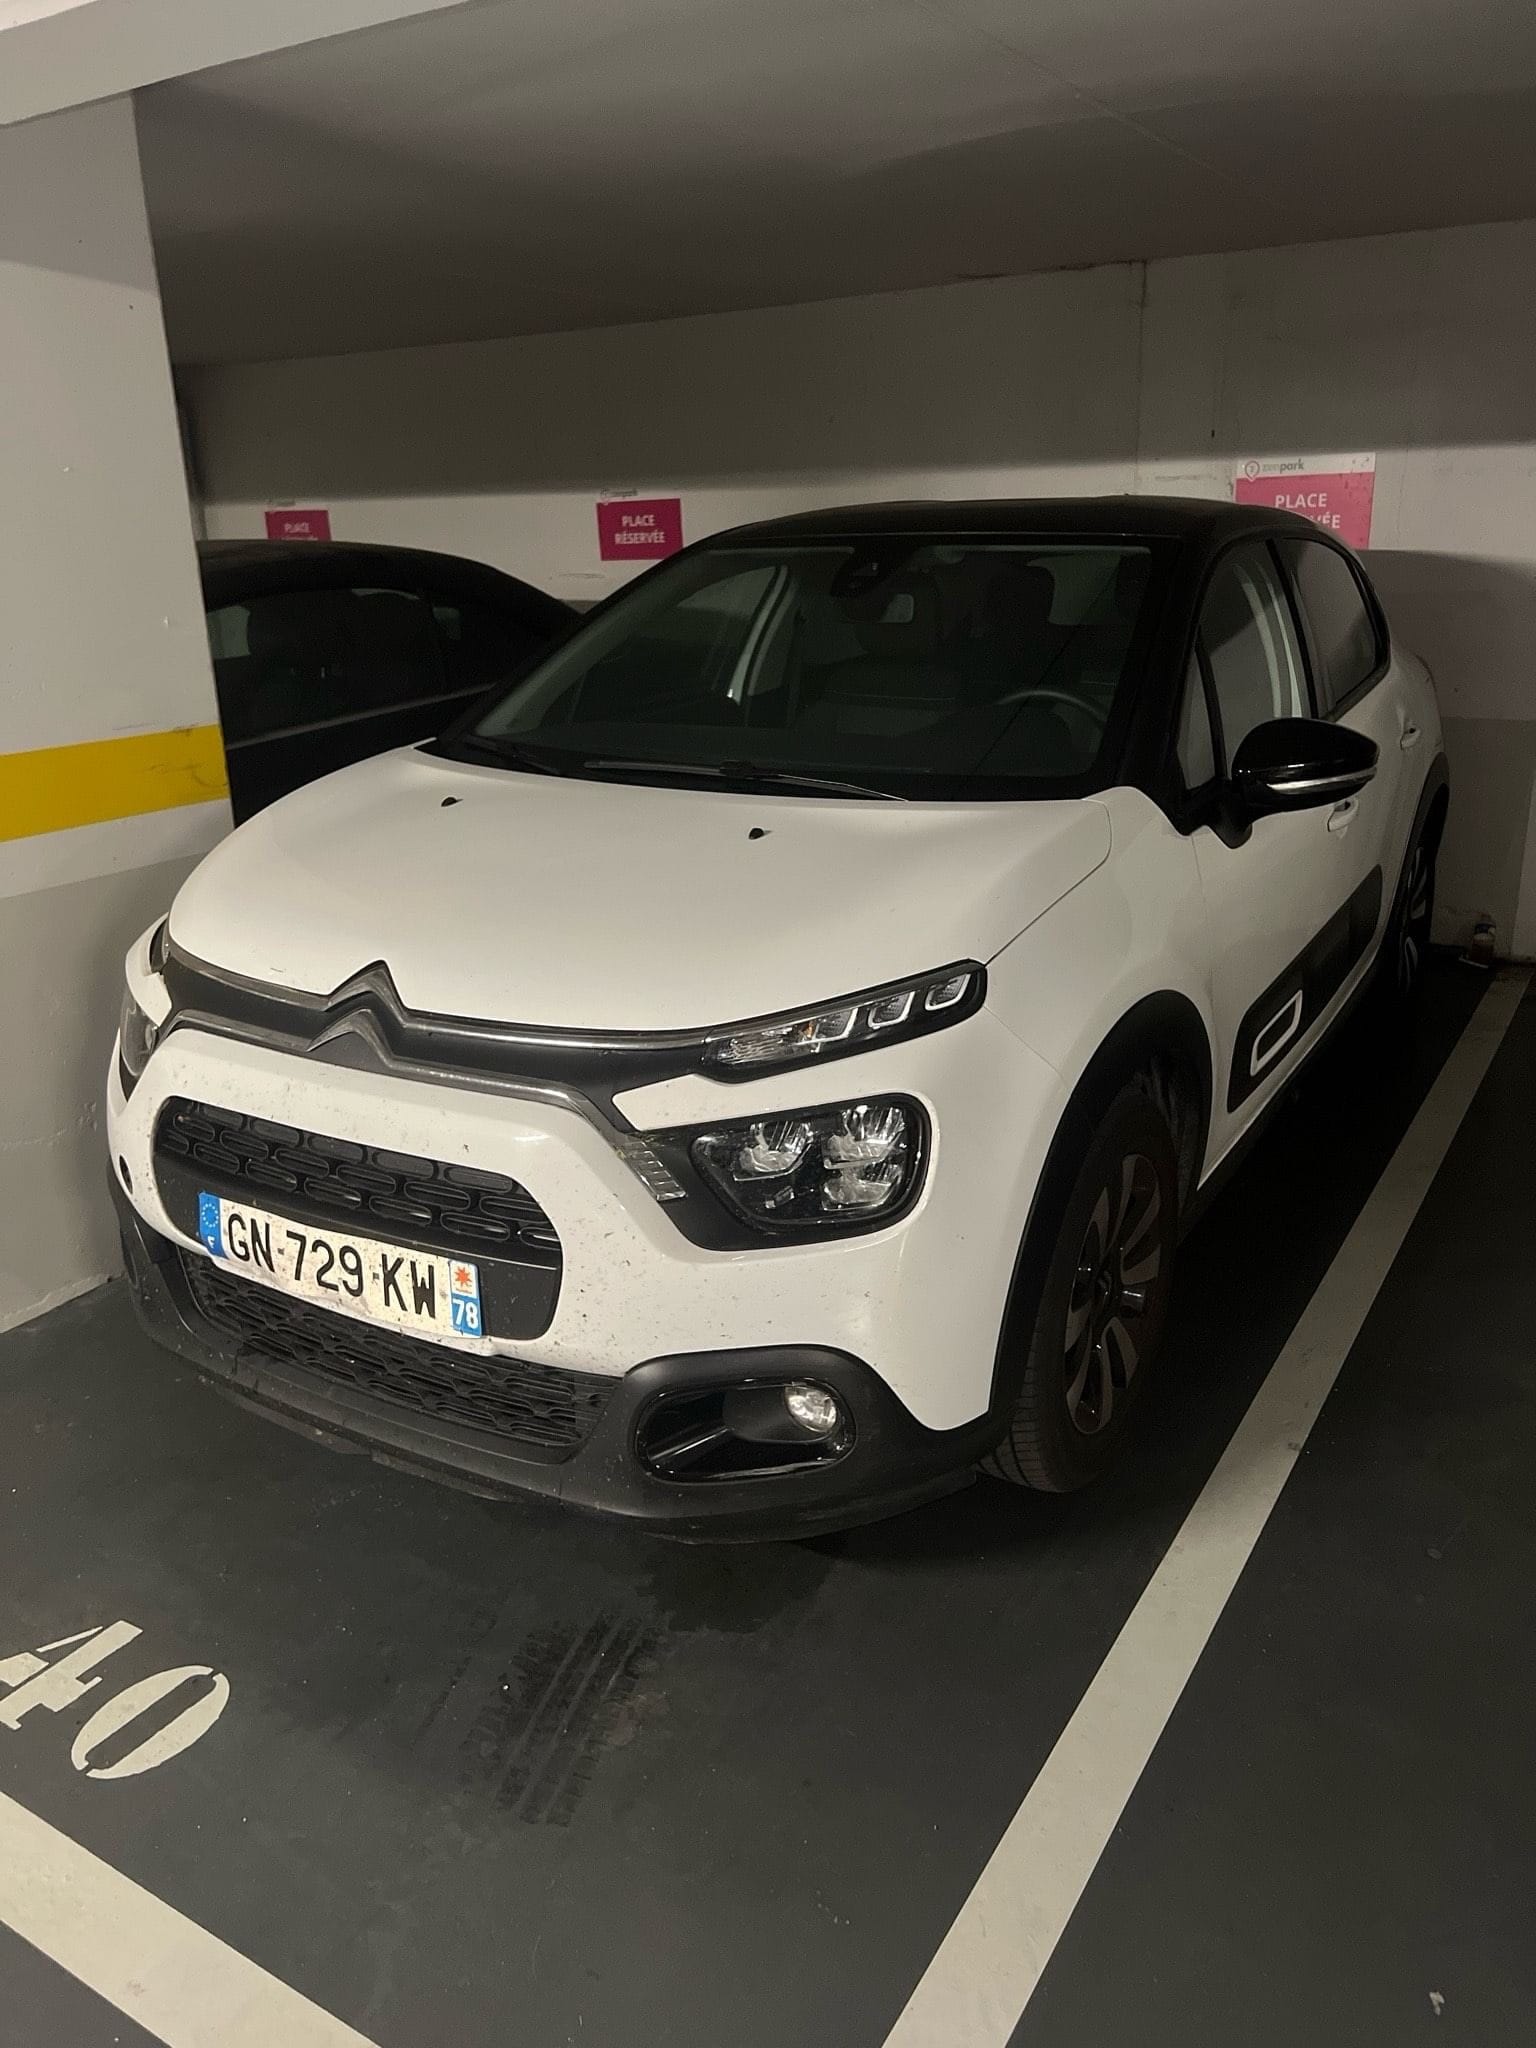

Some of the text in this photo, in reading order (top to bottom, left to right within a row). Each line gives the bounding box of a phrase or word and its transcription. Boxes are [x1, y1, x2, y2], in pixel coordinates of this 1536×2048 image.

[1274, 493, 1328, 508] PLACE
[622, 514, 656, 527] PLACE
[614, 529, 665, 544] RÉSERVÉE
[452, 1298, 479, 1329] 78
